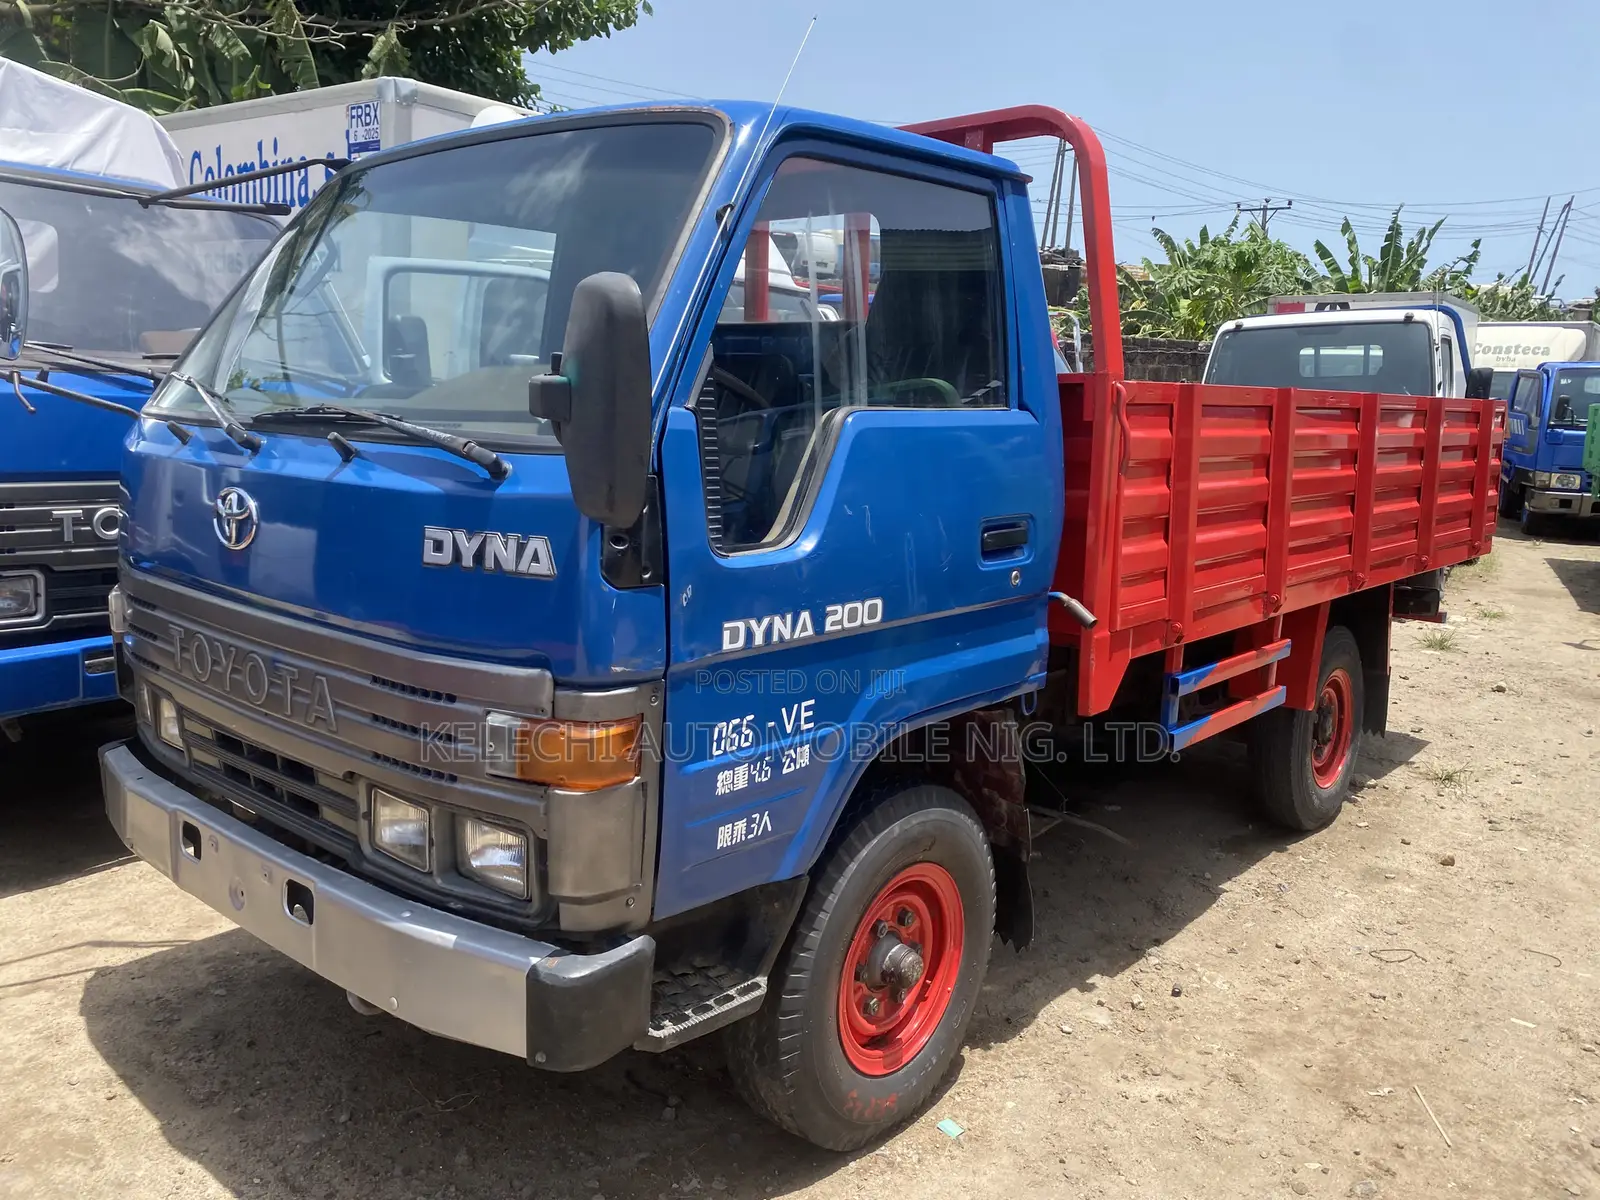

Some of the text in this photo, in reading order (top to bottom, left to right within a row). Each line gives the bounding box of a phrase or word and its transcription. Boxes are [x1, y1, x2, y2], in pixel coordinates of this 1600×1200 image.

[350, 102, 380, 129] FRBX
[1474, 342, 1551, 357] Consteca
[422, 525, 558, 580] DYNA
[721, 597, 884, 652] DYNA 200
[168, 623, 338, 733] TOYOTA
